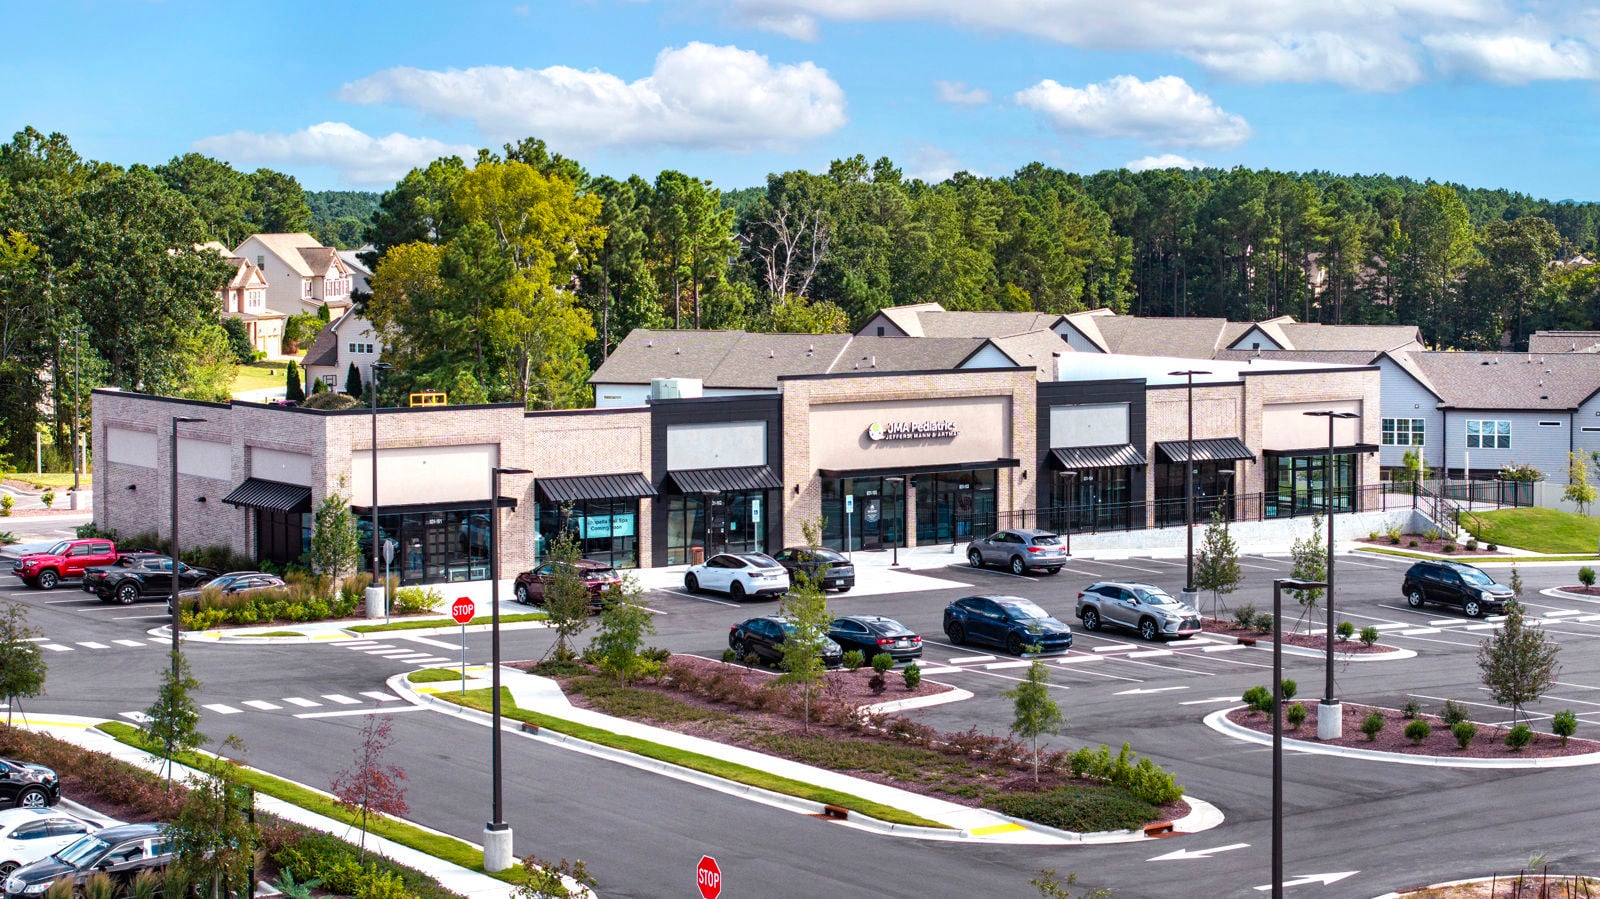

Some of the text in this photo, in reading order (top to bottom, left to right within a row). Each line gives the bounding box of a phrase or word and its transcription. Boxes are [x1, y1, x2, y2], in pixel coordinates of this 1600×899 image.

[887, 420, 958, 433] JMA Pediatrics
[453, 604, 474, 616] STOP
[698, 867, 720, 889] STOP
